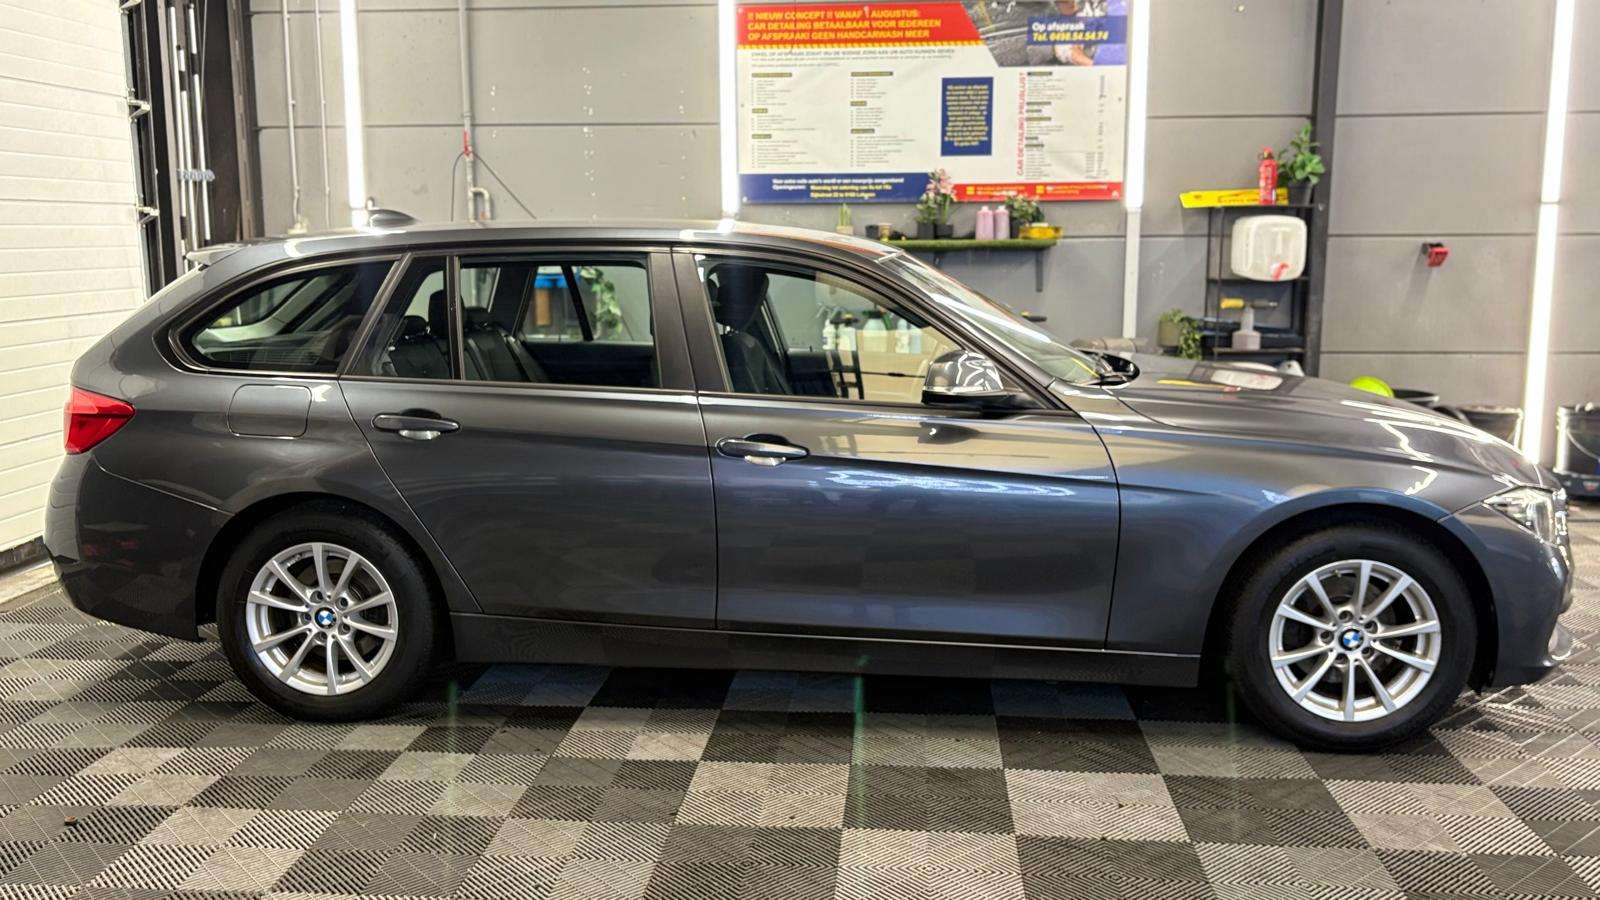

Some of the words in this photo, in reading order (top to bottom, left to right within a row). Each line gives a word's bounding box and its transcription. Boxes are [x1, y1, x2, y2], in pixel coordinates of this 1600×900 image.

[755, 12, 784, 20] NIEUW
[785, 11, 825, 19] CONCEPT
[834, 10, 862, 18] VANAF
[767, 22, 812, 30] DETAILING
[813, 21, 872, 29] BETAALBAAR
[872, 20, 898, 28] VOOR
[898, 20, 942, 28] IEDEREEN
[1032, 22, 1046, 32] Op
[1047, 22, 1085, 32] afspraak
[1016, 116, 1024, 158] DETAILING
